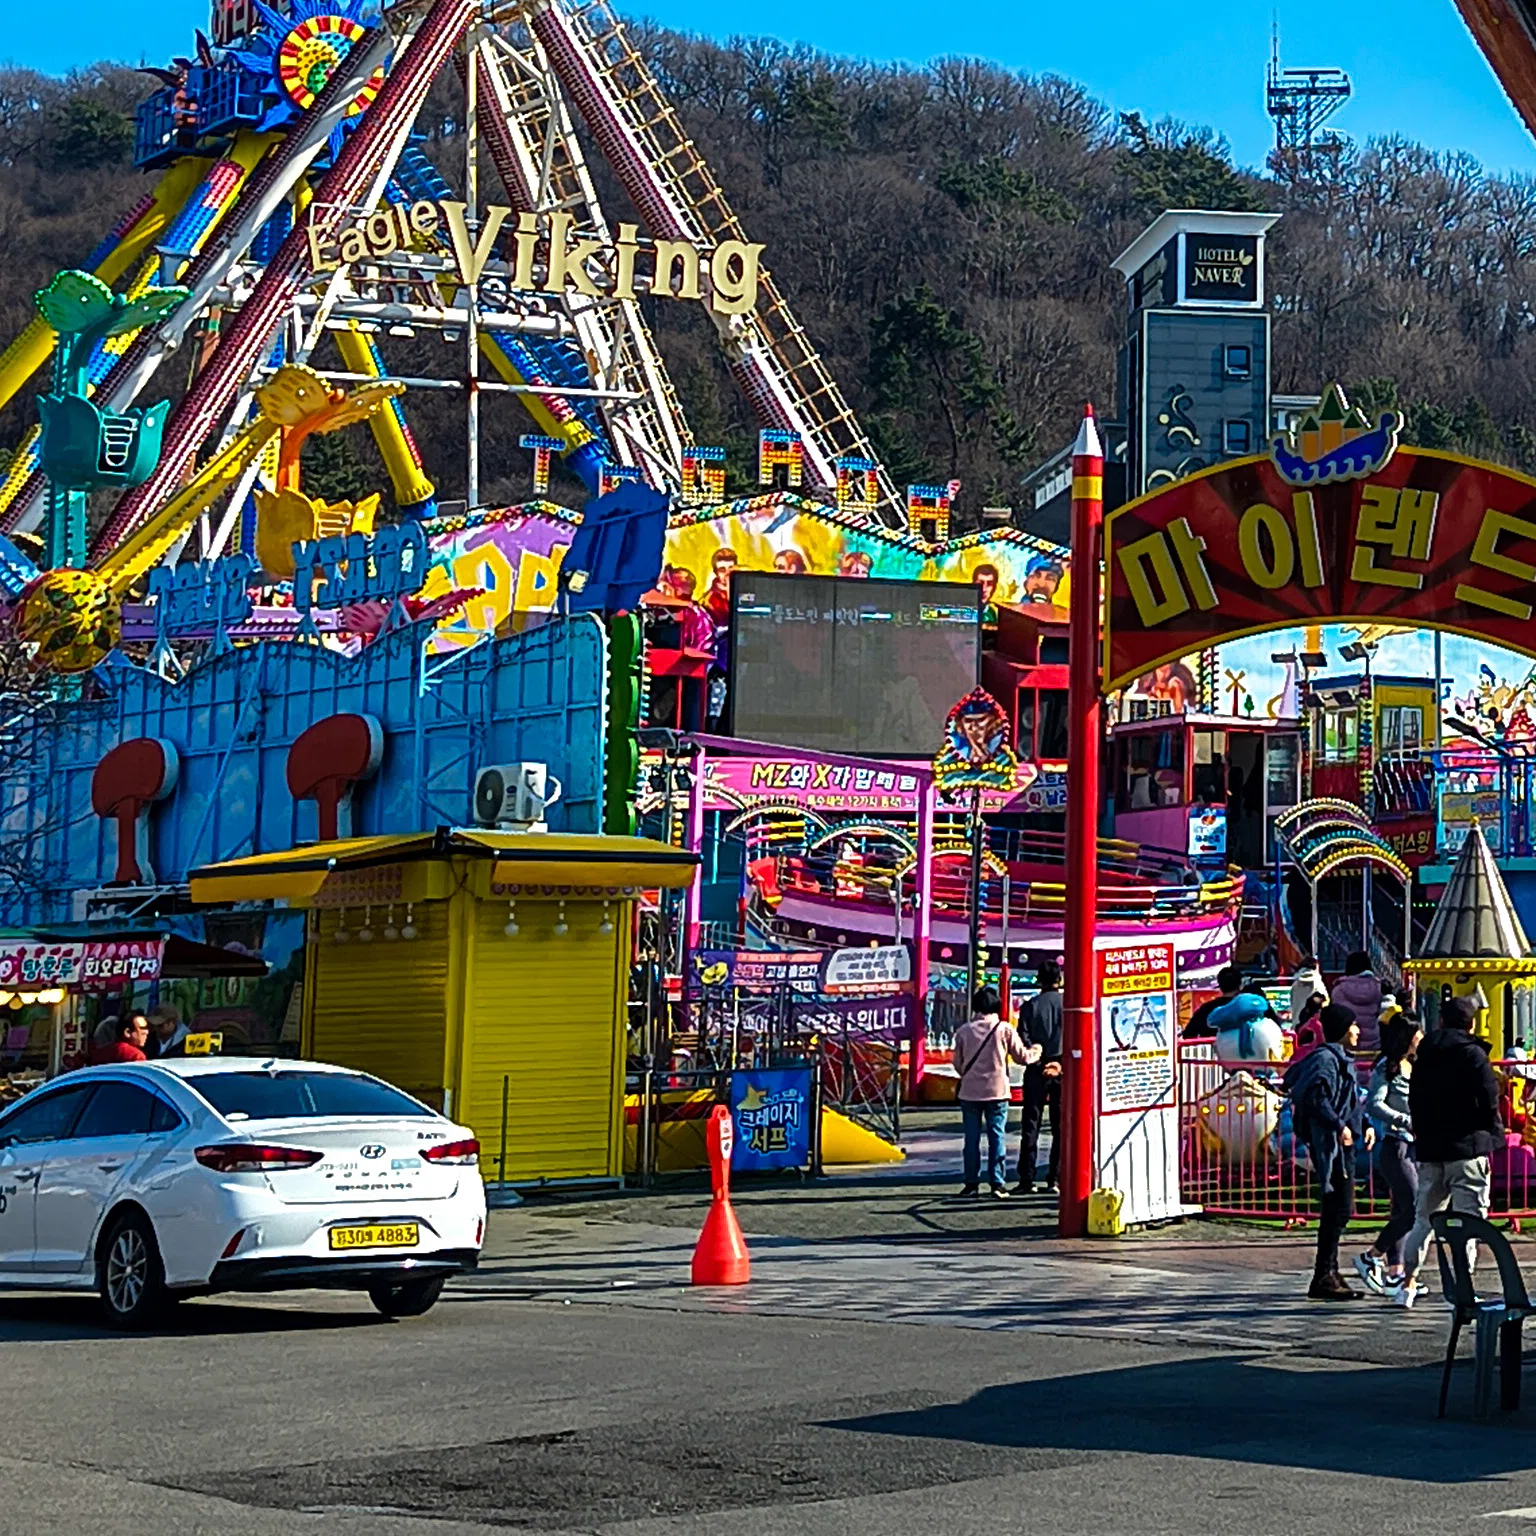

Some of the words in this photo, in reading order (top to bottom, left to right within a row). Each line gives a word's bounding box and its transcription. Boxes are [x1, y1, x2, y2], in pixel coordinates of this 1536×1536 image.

[306, 200, 438, 272] Eagle
[438, 200, 767, 314] Viking
[1198, 248, 1238, 262] HOTEL
[1192, 268, 1246, 287] NAVER
[752, 763, 810, 789] MZ와
[1385, 830, 1432, 856] 퍼스윙
[23, 958, 74, 982] 탕후루
[84, 957, 157, 978] 회오리감자
[741, 1102, 798, 1127] 크레이지
[750, 1126, 787, 1152] 서프
